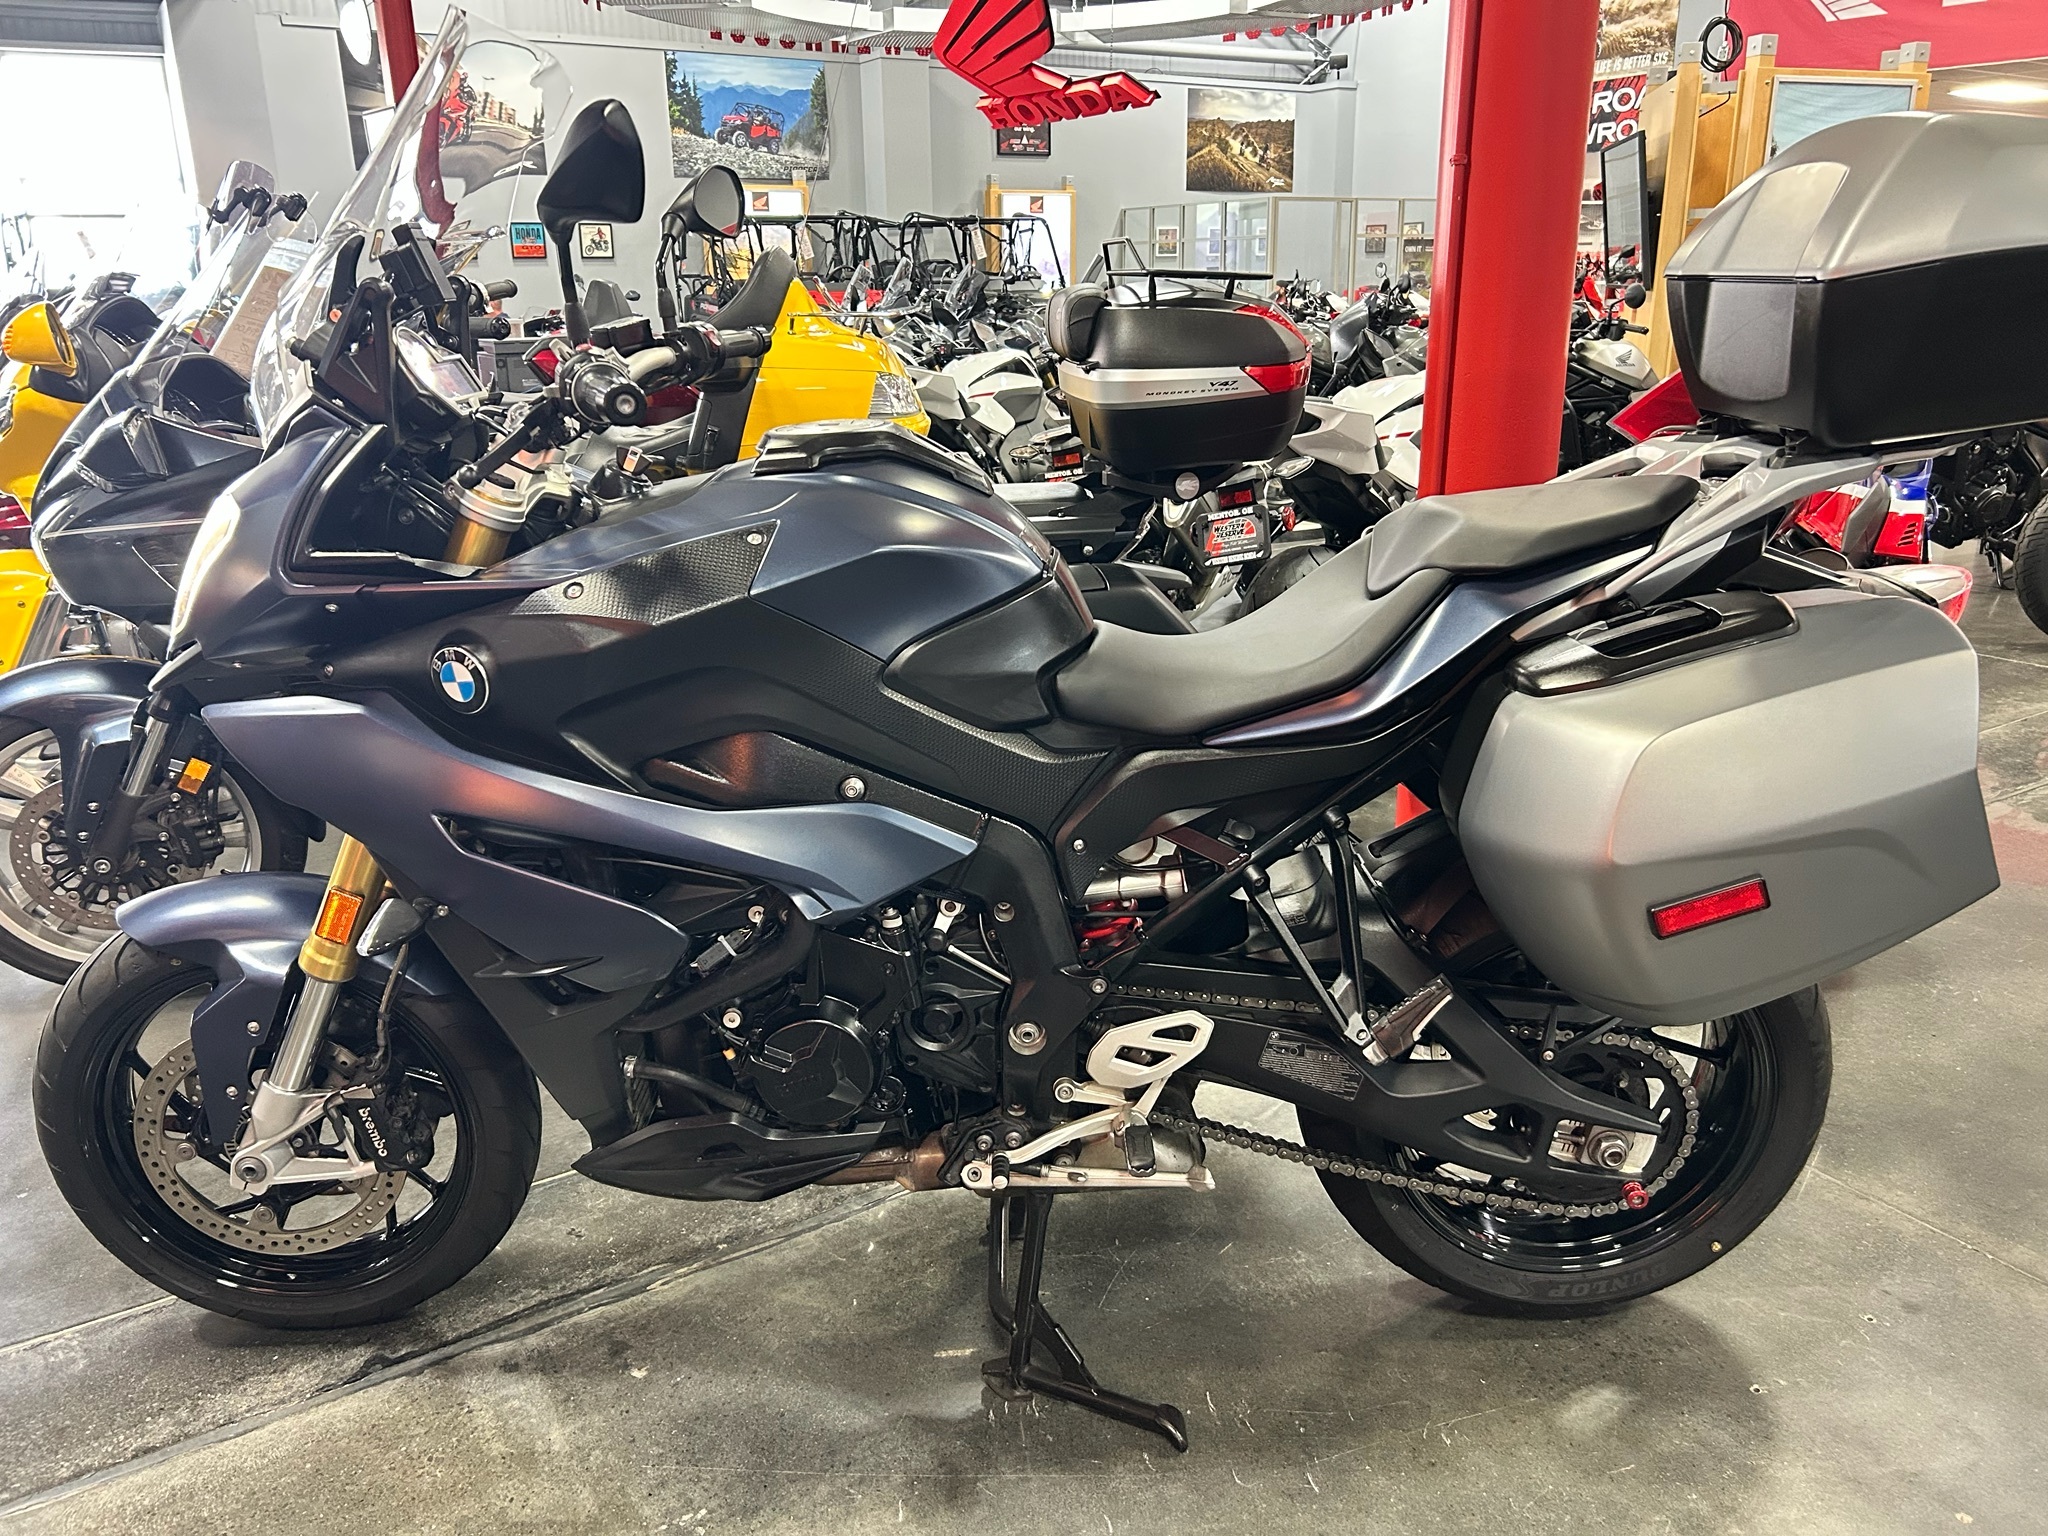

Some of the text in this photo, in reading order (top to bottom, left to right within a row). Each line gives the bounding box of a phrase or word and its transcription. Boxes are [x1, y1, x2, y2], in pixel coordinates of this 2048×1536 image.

[1612, 57, 1622, 71] IS
[1622, 54, 1652, 70] BETTER
[1652, 51, 1669, 66] SXS
[977, 78, 1158, 129] HONDA
[515, 227, 542, 240] HONDA
[1145, 389, 1198, 397] MONOKEY
[1209, 380, 1239, 388] V47
[432, 649, 477, 672] BMW
[358, 1106, 389, 1157] brembo
